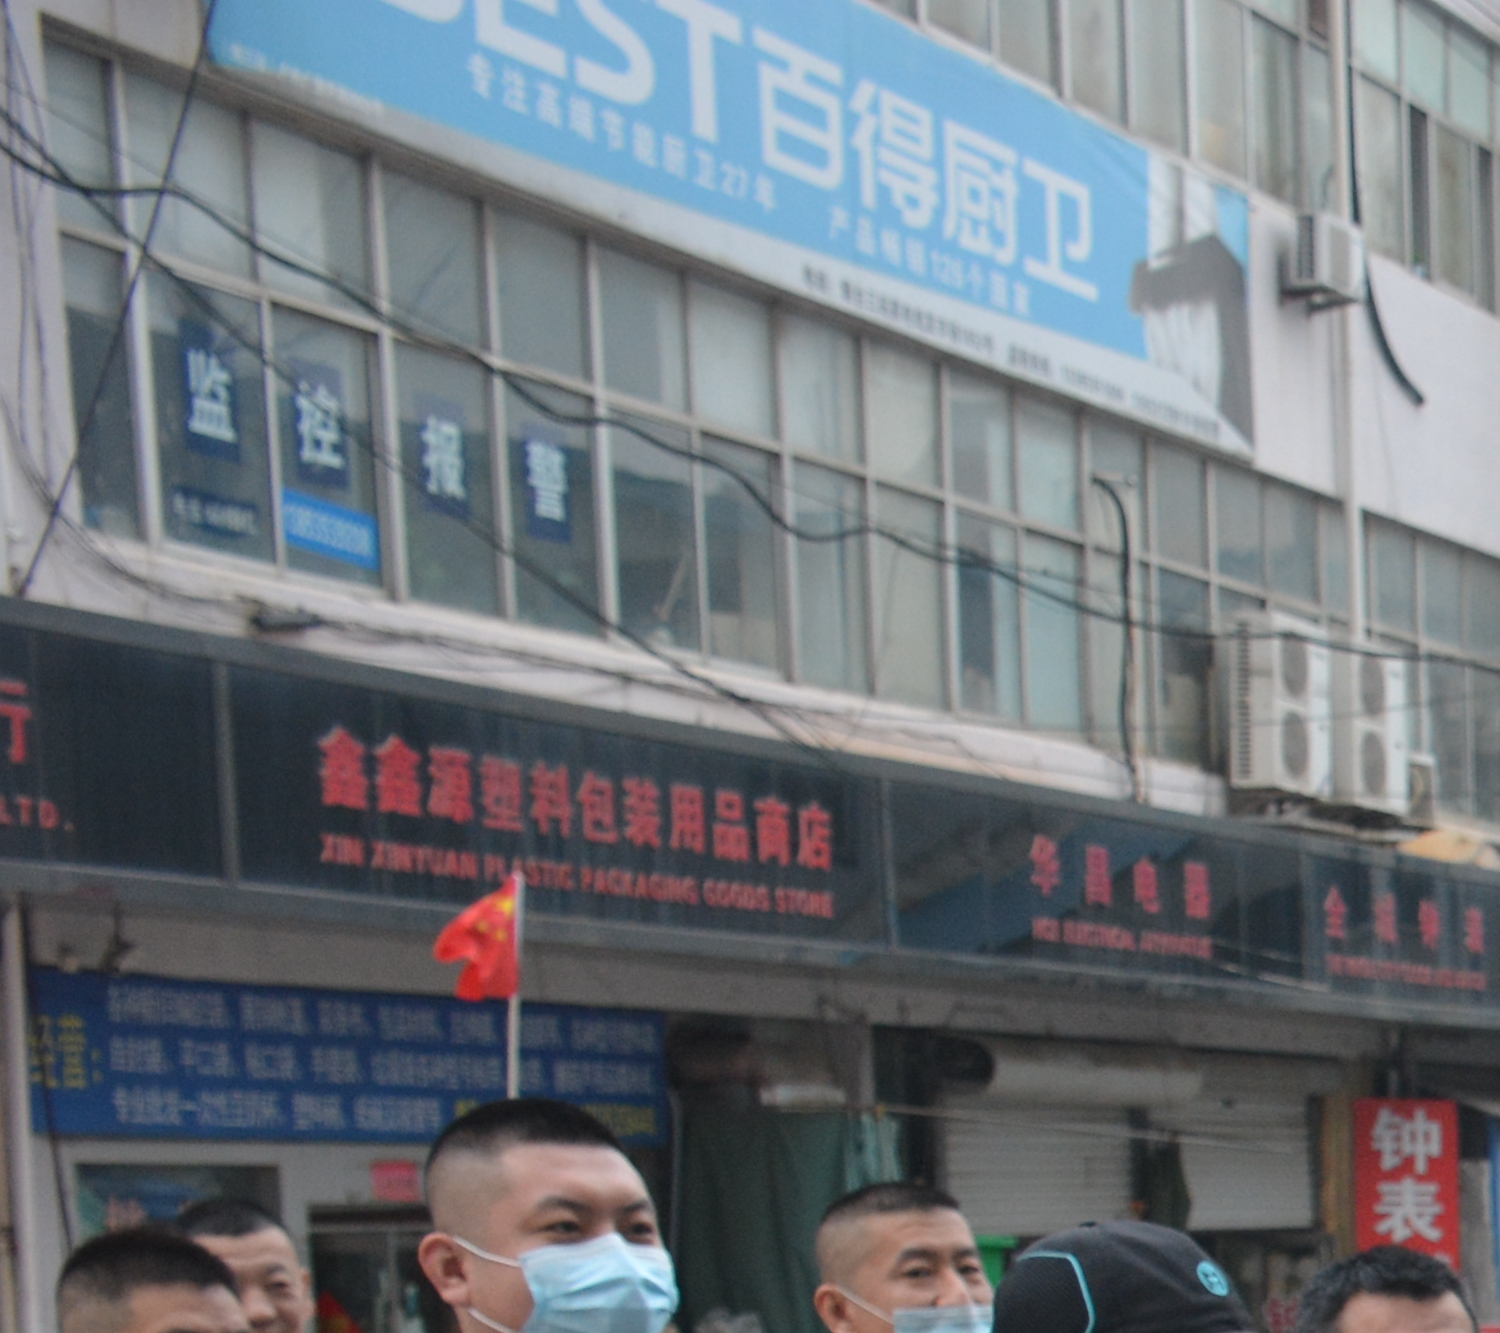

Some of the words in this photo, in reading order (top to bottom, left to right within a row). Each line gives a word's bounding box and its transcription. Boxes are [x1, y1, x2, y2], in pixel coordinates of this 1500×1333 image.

[752, 27, 1097, 300] 百得厨卫
[318, 725, 833, 872] 鑫鑫源塑料包装用品商店
[1370, 1105, 1446, 1244] 钟表
